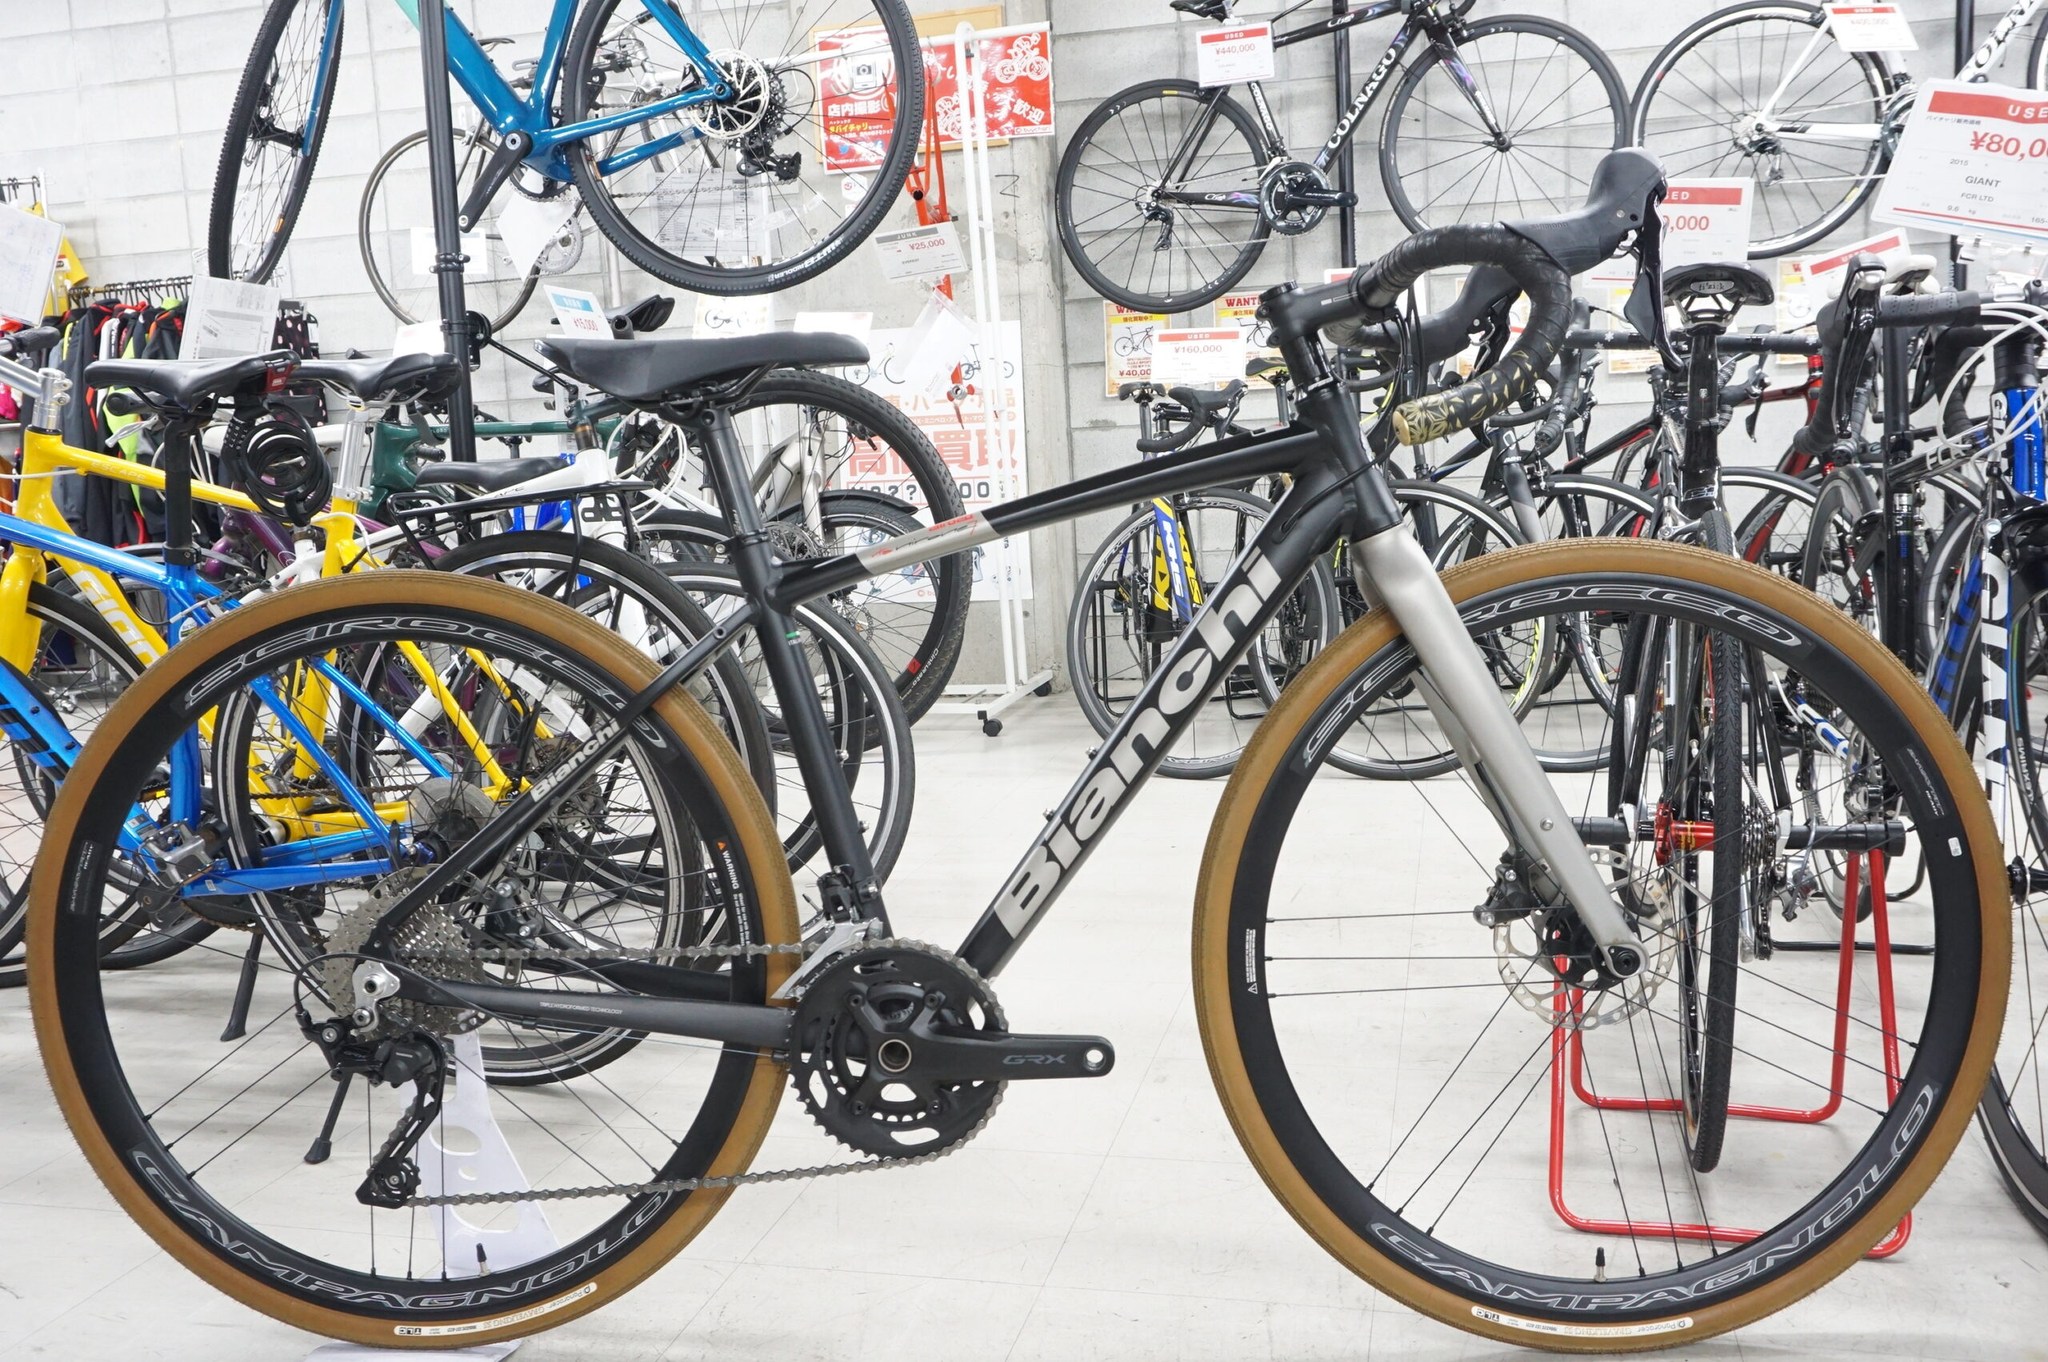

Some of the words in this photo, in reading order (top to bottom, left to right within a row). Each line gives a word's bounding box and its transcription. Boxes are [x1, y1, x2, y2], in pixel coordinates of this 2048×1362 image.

[1216, 43, 1256, 55] ¥440,000
[1327, 47, 1397, 149] COLNAGO
[1250, 82, 1274, 131] COLNAGO
[1949, 158, 1969, 166] 2015
[1965, 176, 2001, 188] GIANT
[1664, 191, 1690, 200] SED
[1961, 193, 1977, 201] FCR
[1978, 194, 1994, 202] LTD
[897, 232, 917, 240] JUNK
[909, 238, 945, 250] ¥25,000
[1225, 297, 1262, 308] WANT
[1174, 345, 1222, 354] ¥160,000
[91, 460, 146, 481] ESCAPE
[994, 549, 1282, 939] Bianchi
[530, 721, 622, 803] Bianchi
[722, 850, 739, 890] WARNING
[1002, 1053, 1067, 1066] GRX
[1370, 1083, 1935, 1310] CAMPAGNOLO
[133, 1148, 673, 1310] CAMPAGNOLO
[548, 1290, 582, 1308] Panaracer
[1637, 1323, 1676, 1334] Panaracer
